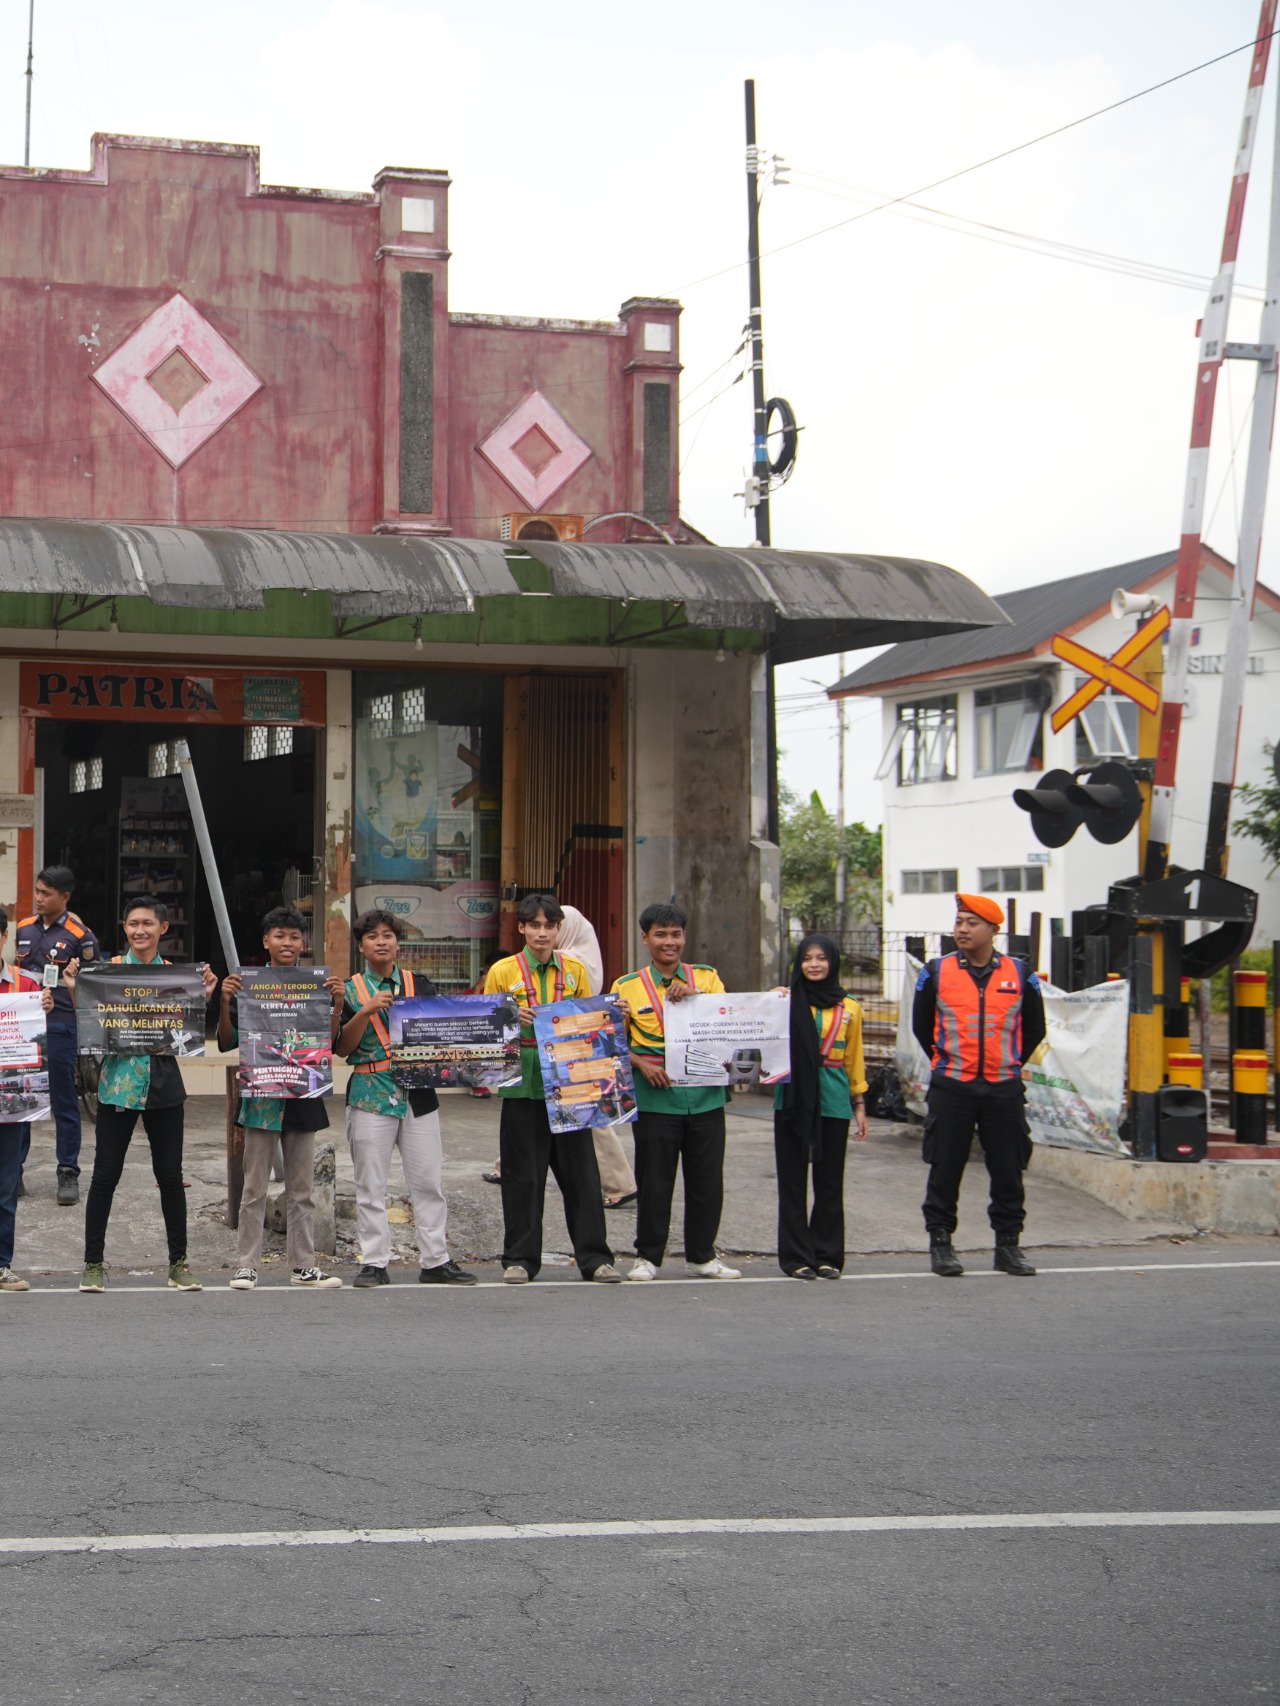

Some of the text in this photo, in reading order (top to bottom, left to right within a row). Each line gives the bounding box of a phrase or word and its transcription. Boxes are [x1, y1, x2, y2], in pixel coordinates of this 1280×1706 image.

[36, 672, 219, 712] PATRIA
[1184, 879, 1201, 910] 1
[384, 898, 411, 914] Zee
[467, 898, 493, 914] Zee
[125, 988, 152, 997] STOP
[97, 1003, 182, 1012] DAHULUKAN KA
[98, 1019, 184, 1028] YANG MELINTAS
[253, 1066, 303, 1075] PENTINGNYA
